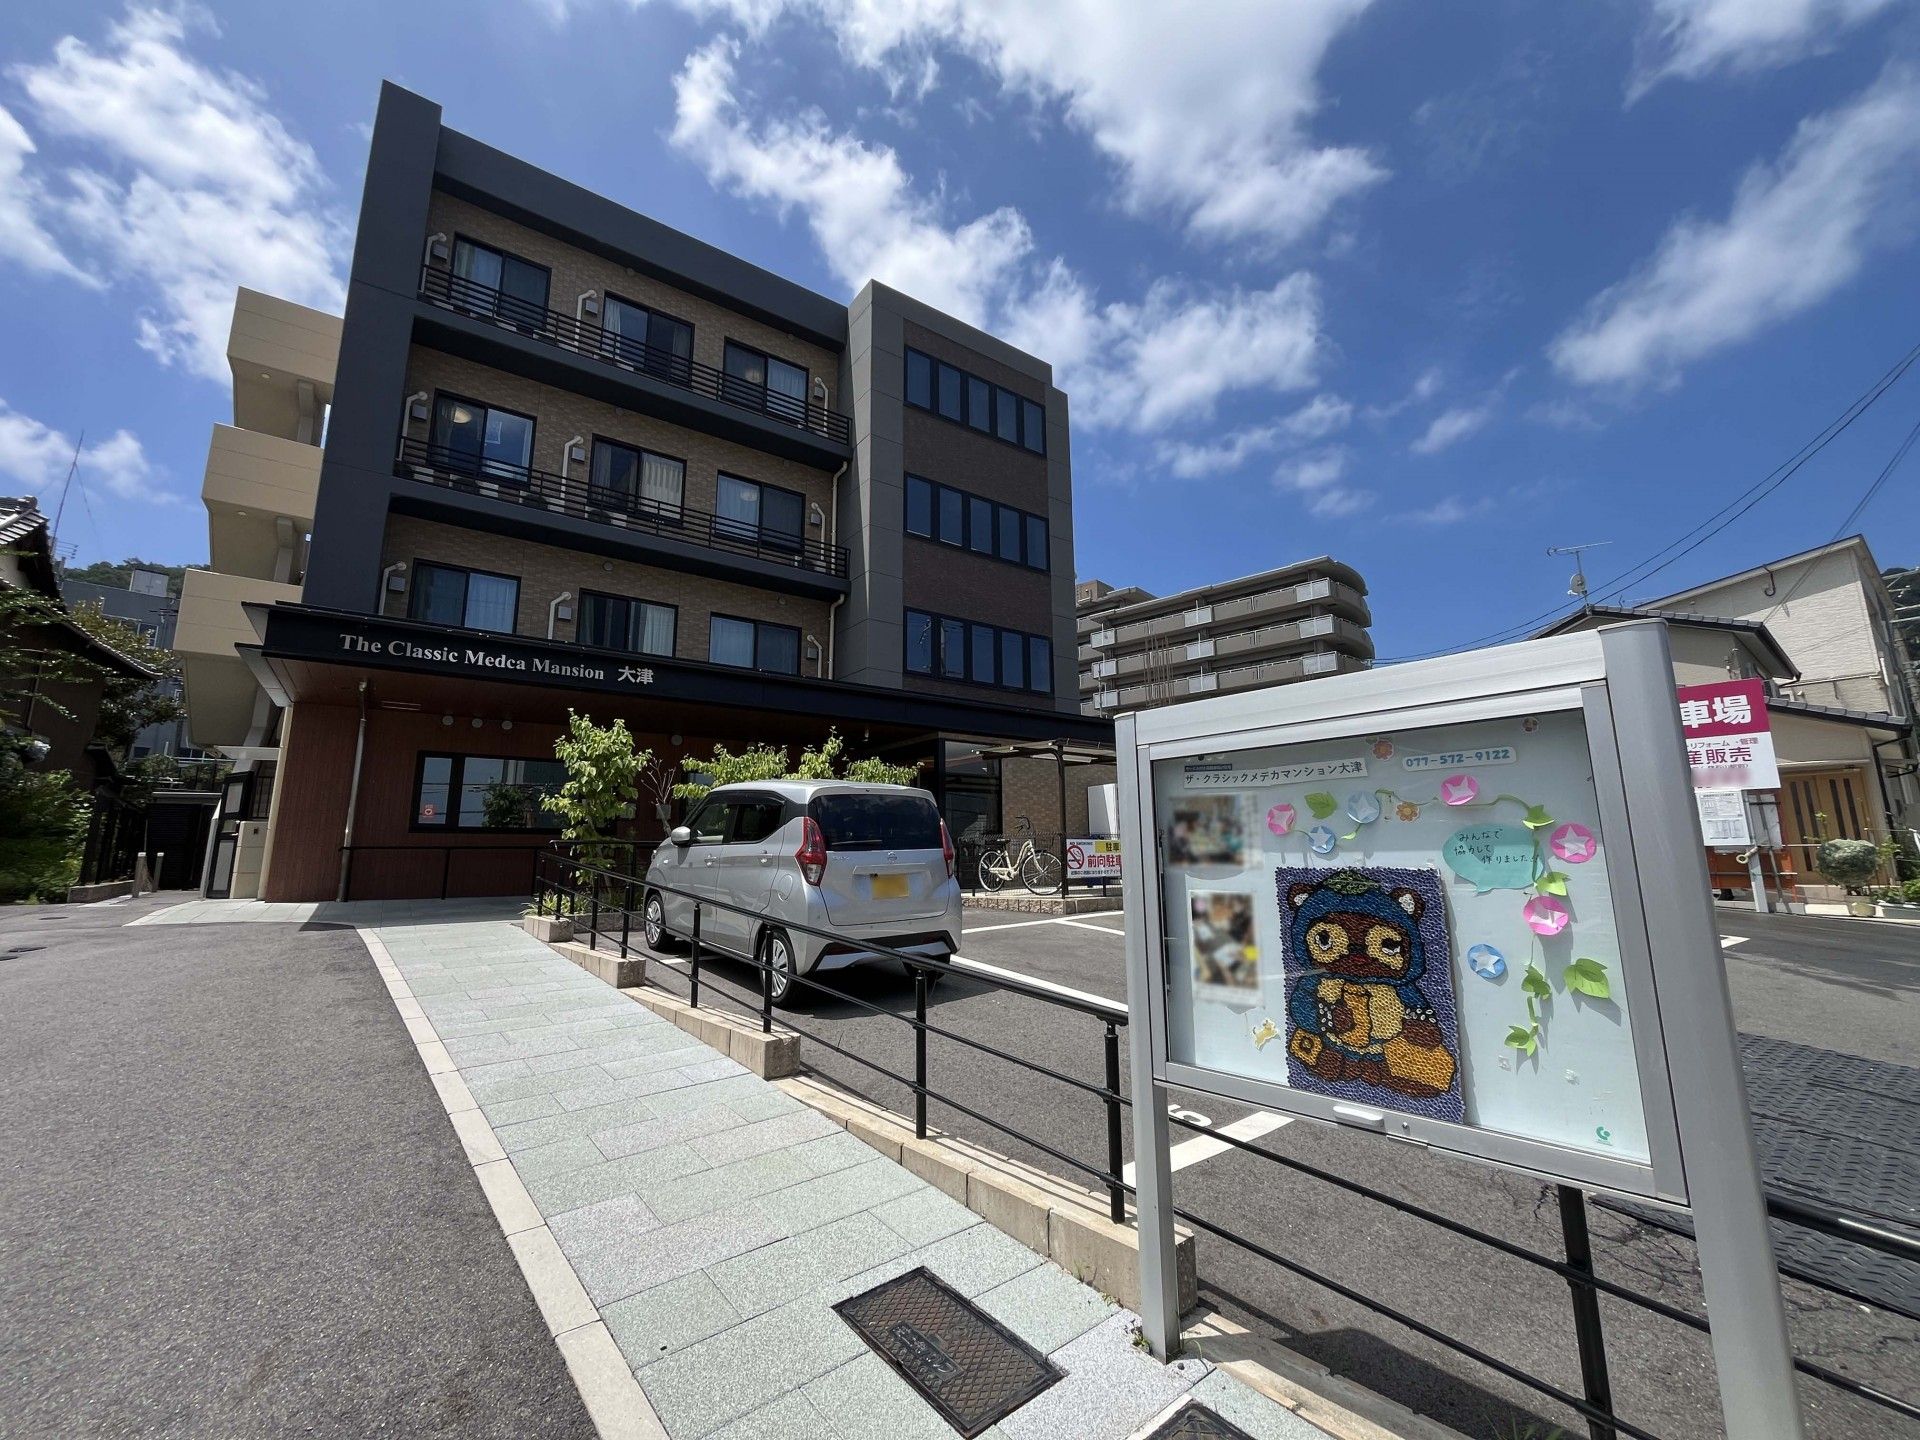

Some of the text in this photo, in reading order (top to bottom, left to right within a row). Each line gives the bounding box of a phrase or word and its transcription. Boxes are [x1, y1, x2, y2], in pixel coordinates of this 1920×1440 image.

[340, 633, 654, 685] The Classic Medca Mansion 大津
[1679, 694, 1752, 729] 車場
[1406, 749, 1511, 768] 077-572-9122
[1185, 761, 1363, 785] ザ・クラシックメデカマンション大津
[1459, 828, 1503, 841] みんなで
[1454, 844, 1492, 856] 協力して
